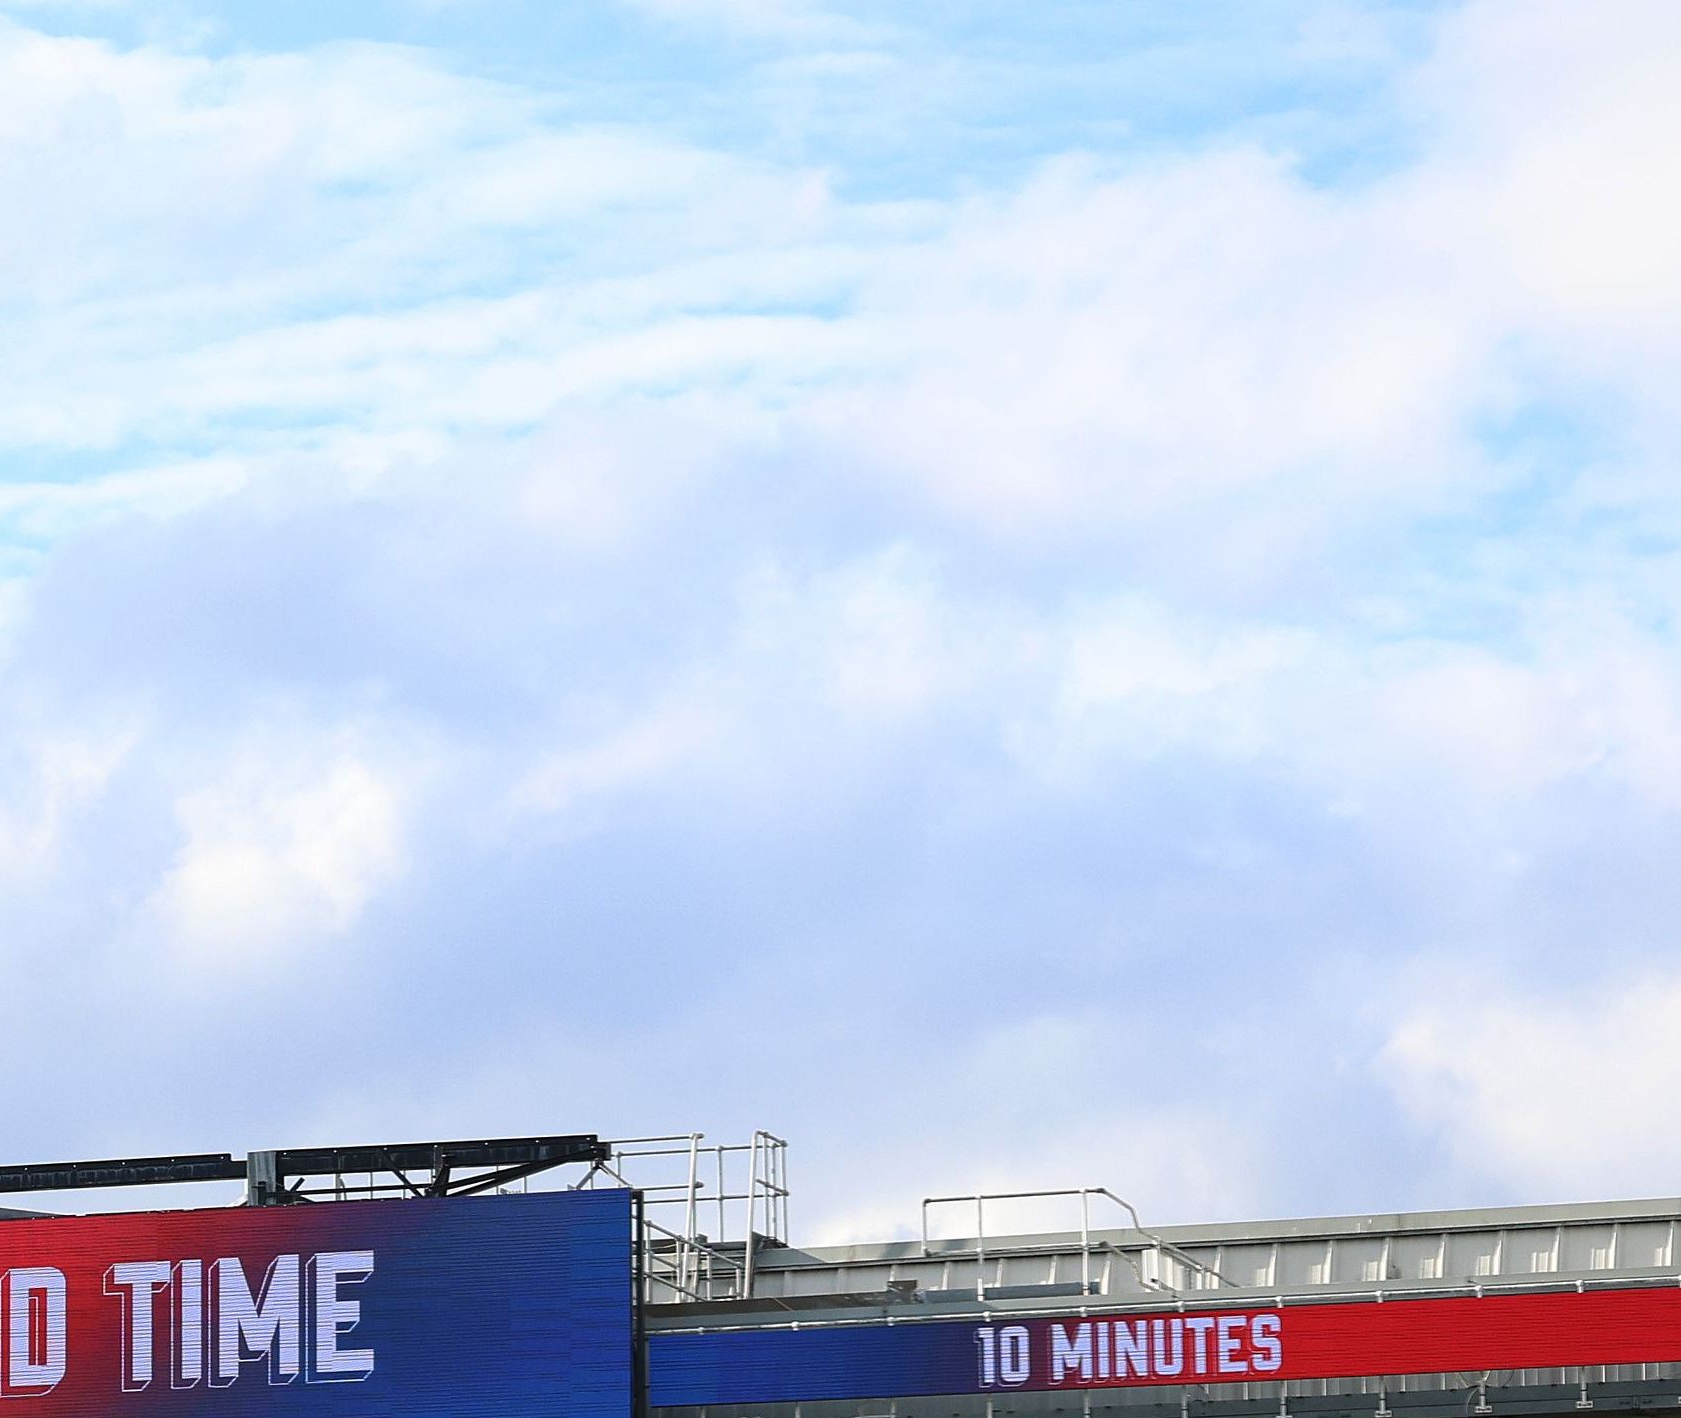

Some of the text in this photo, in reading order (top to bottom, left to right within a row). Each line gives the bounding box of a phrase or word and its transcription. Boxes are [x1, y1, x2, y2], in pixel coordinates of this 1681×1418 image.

[104, 1251, 375, 1392] TIME
[974, 1314, 1282, 1388] 10 MINUTES
